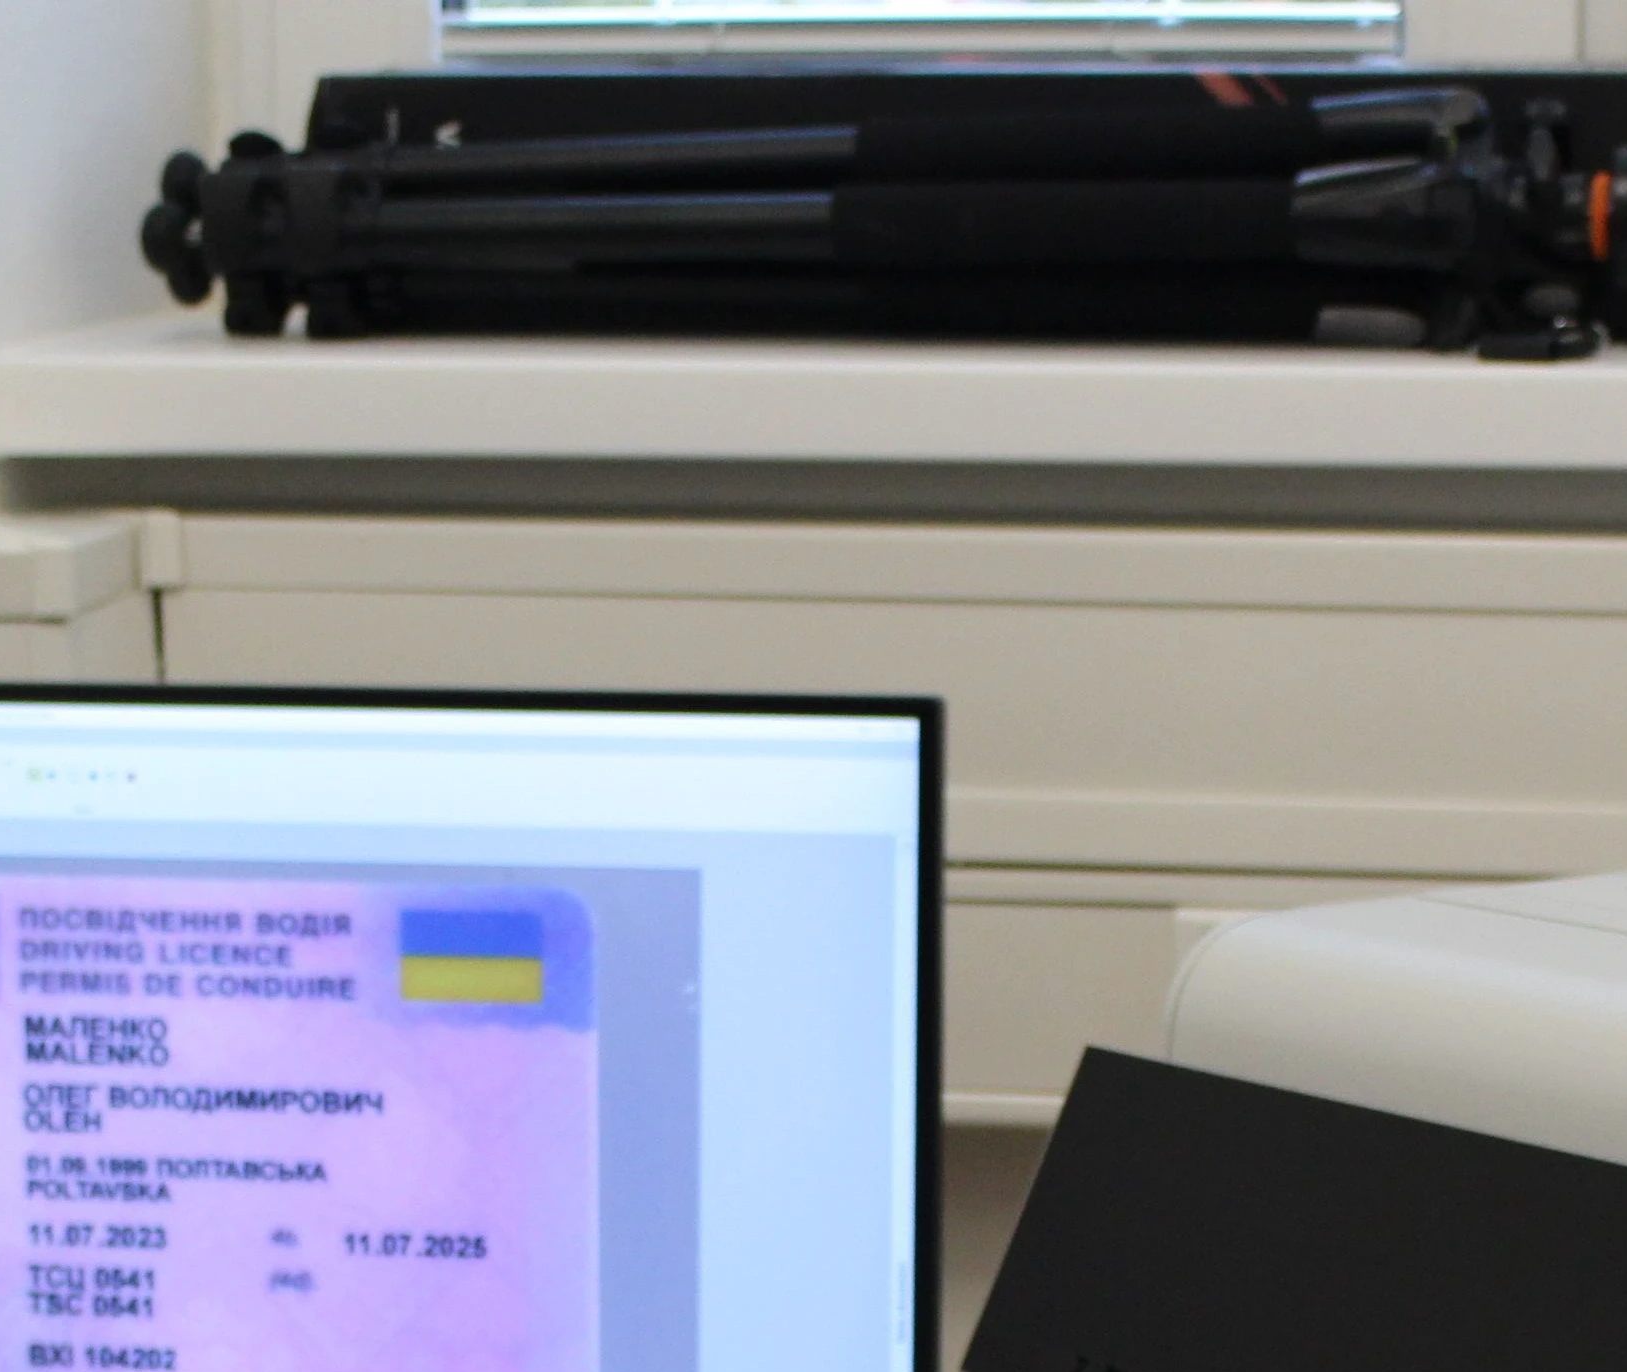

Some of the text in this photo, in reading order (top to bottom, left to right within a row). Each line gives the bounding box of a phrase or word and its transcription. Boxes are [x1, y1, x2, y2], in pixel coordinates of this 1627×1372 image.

[17, 906, 353, 939] ПОСВІДЧЕННЯ ВОДІЯ
[18, 939, 291, 967] DRIVING LICENCE
[18, 970, 357, 1001] PERMIS DE CONDUIRE
[24, 1014, 168, 1040] МАЛЕНКО
[25, 1041, 170, 1066] MALENKO
[23, 1083, 384, 1115] ОЛЕГ ВОЛОДИМИРОВИЧ
[23, 1109, 103, 1133] OLEH
[29, 1223, 168, 1249] 11.07.2023
[345, 1232, 487, 1259] 11.07.2025
